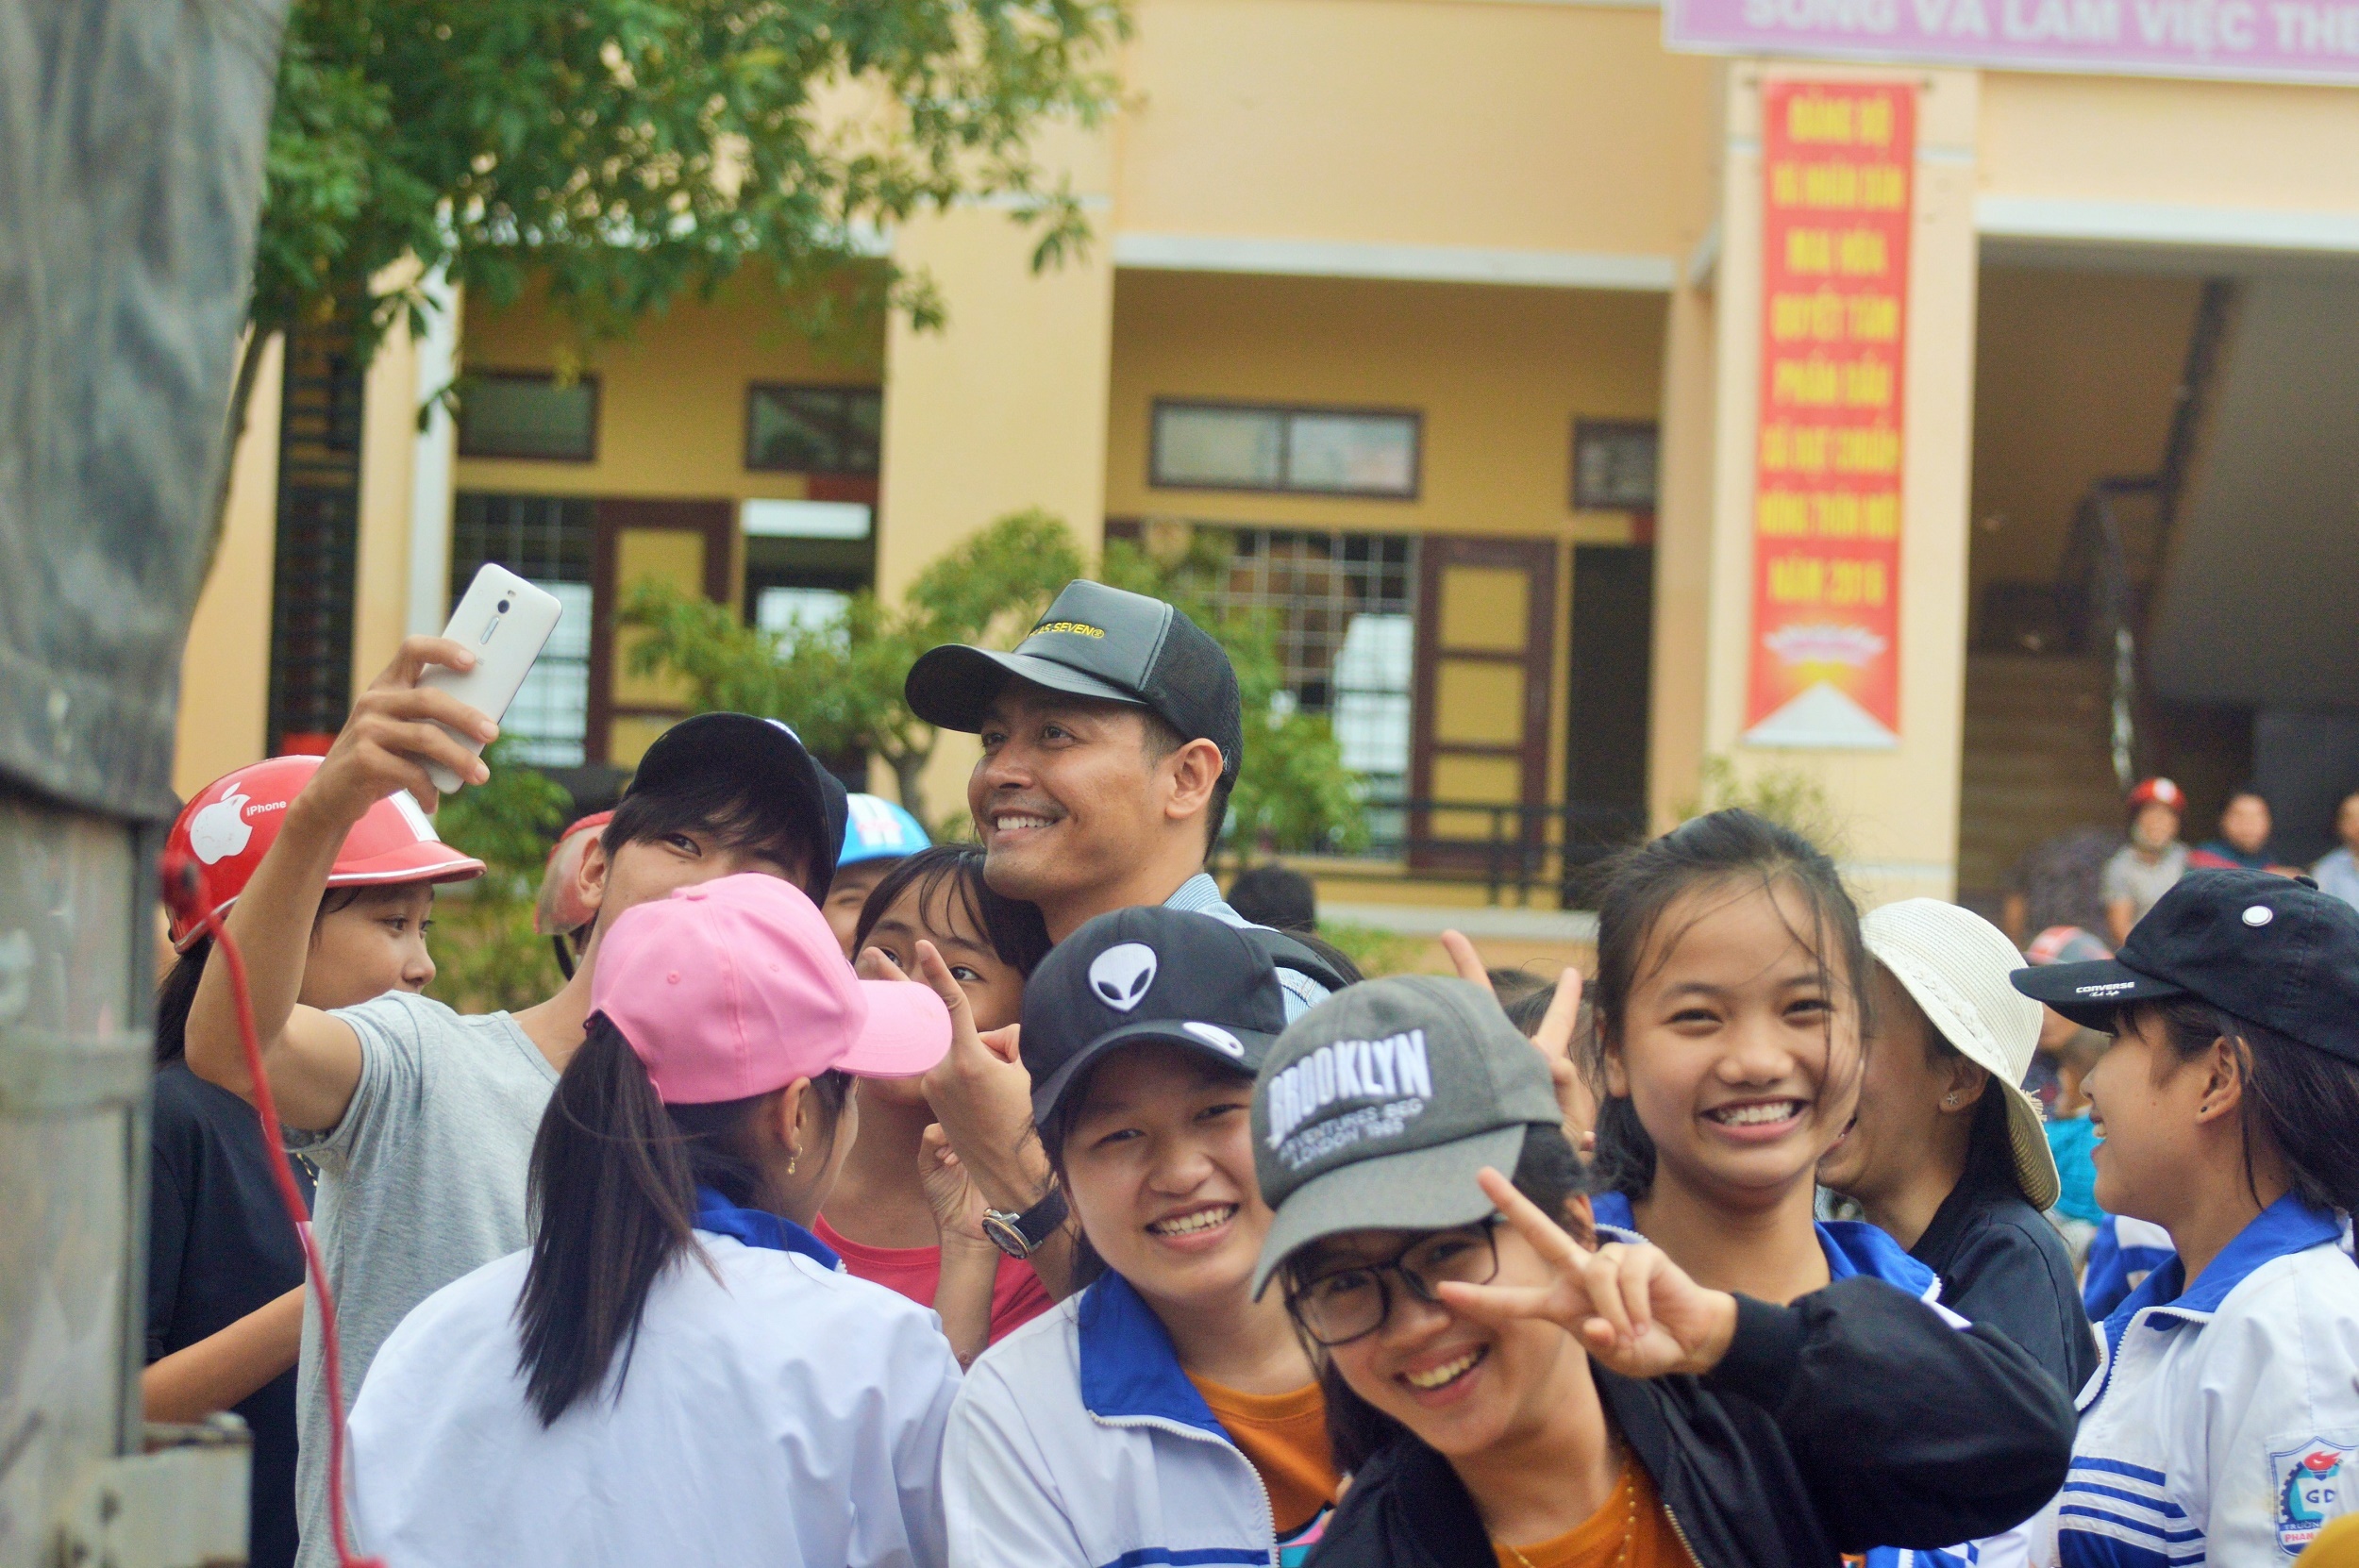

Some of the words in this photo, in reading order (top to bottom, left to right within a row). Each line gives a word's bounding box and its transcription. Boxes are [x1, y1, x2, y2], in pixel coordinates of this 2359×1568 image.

[246, 800, 287, 817] iPhone
[2076, 982, 2134, 993] CONVERSE
[1265, 1028, 1432, 1149] BROOKLYN
